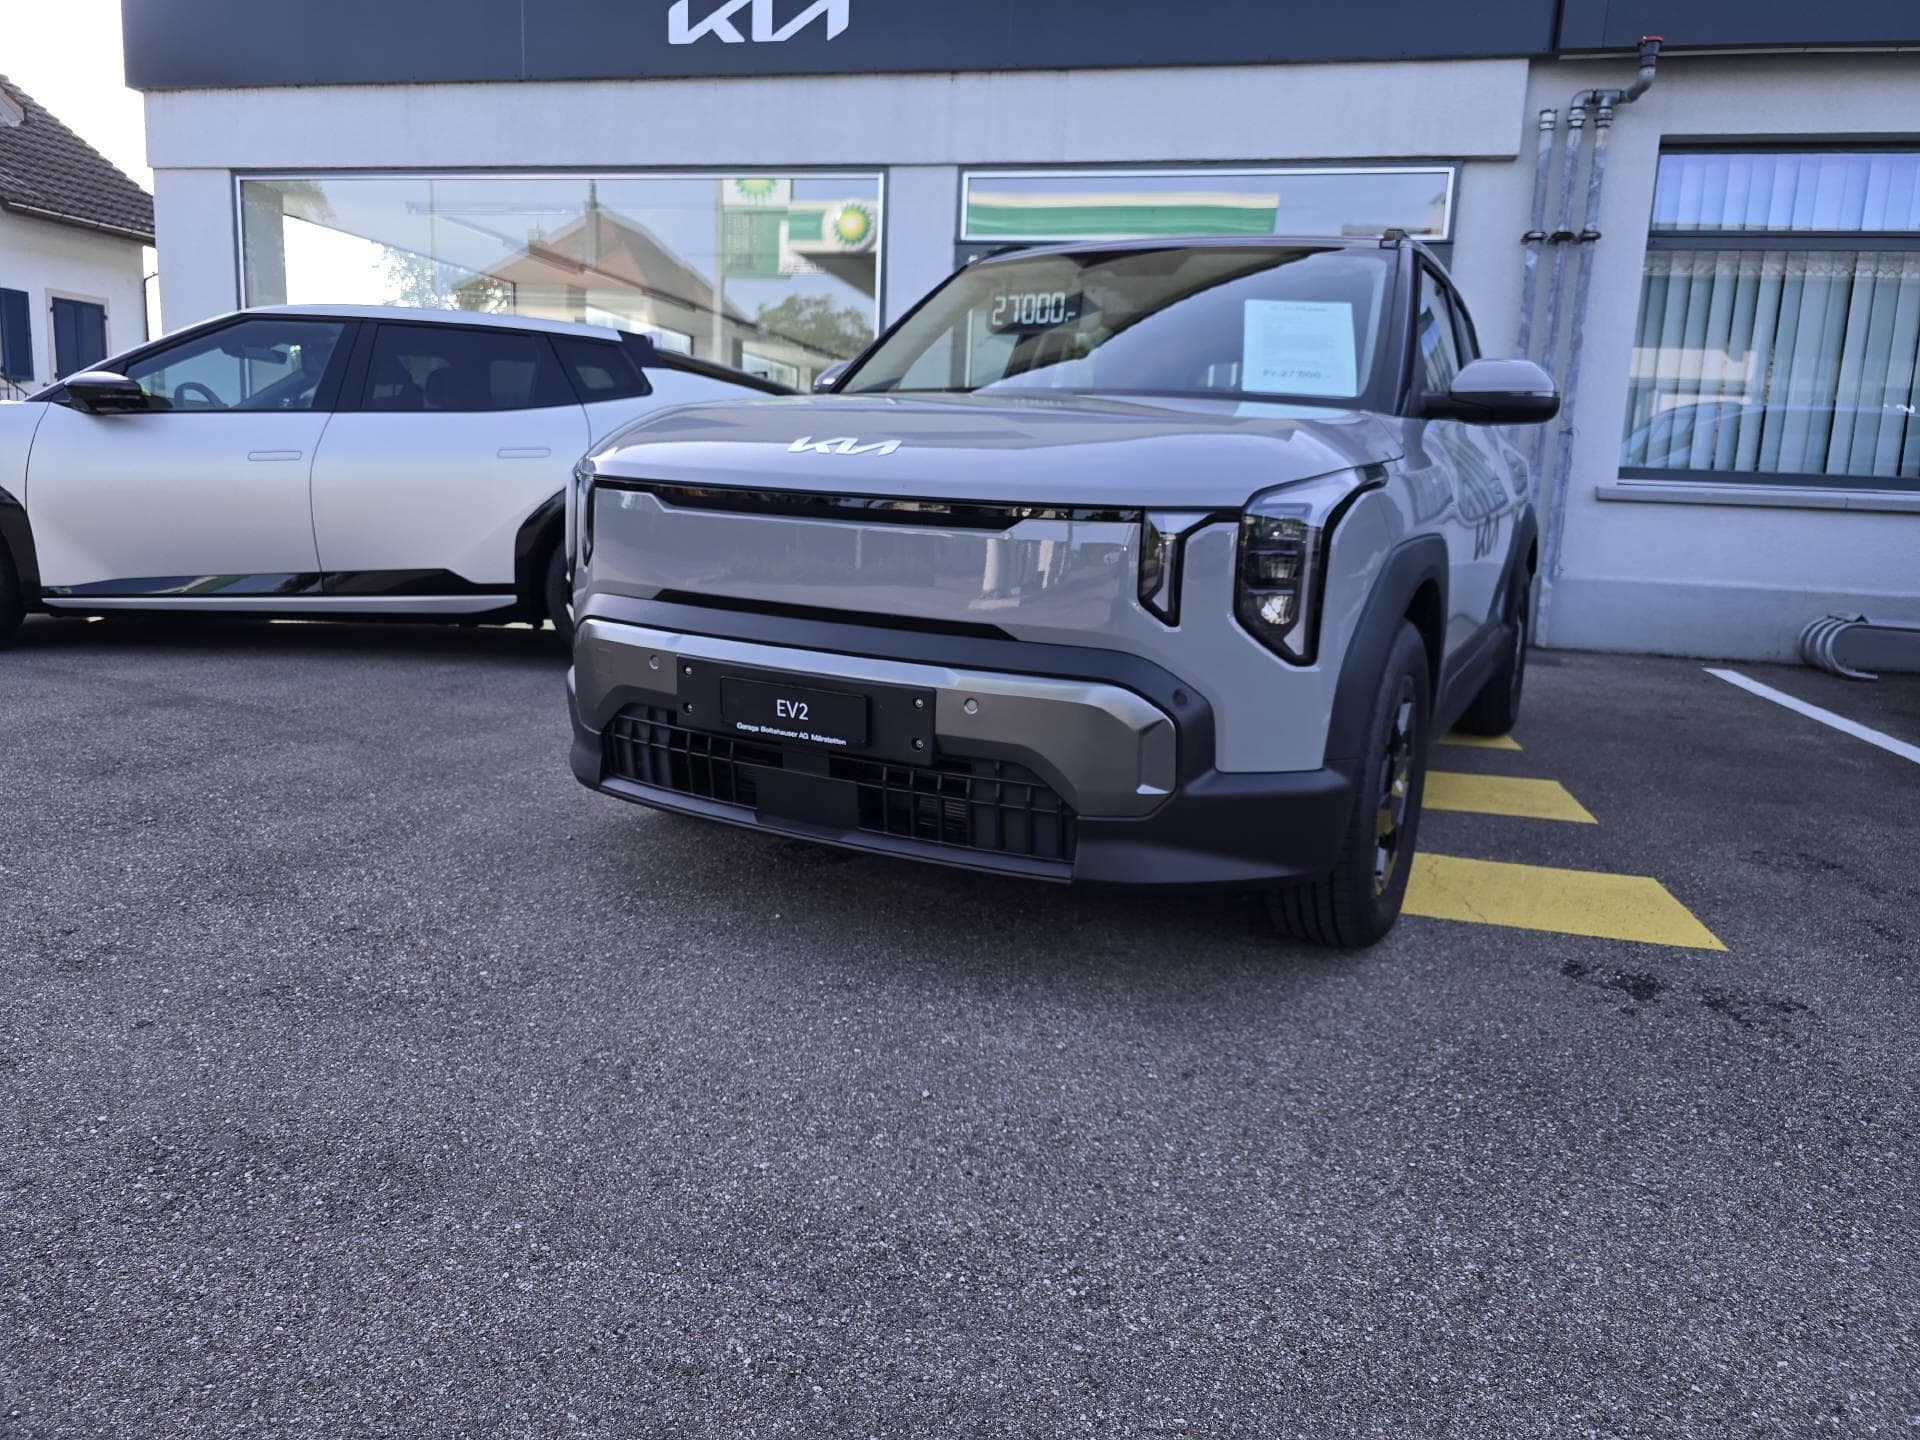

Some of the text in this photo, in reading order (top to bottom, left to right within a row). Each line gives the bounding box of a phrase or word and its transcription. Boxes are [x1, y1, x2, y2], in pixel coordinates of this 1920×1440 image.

[668, 0, 850, 45] KIA
[787, 435, 902, 456] KIA
[776, 699, 808, 720] EV2
[736, 722, 759, 732] Garage
[799, 732, 809, 740] AG
